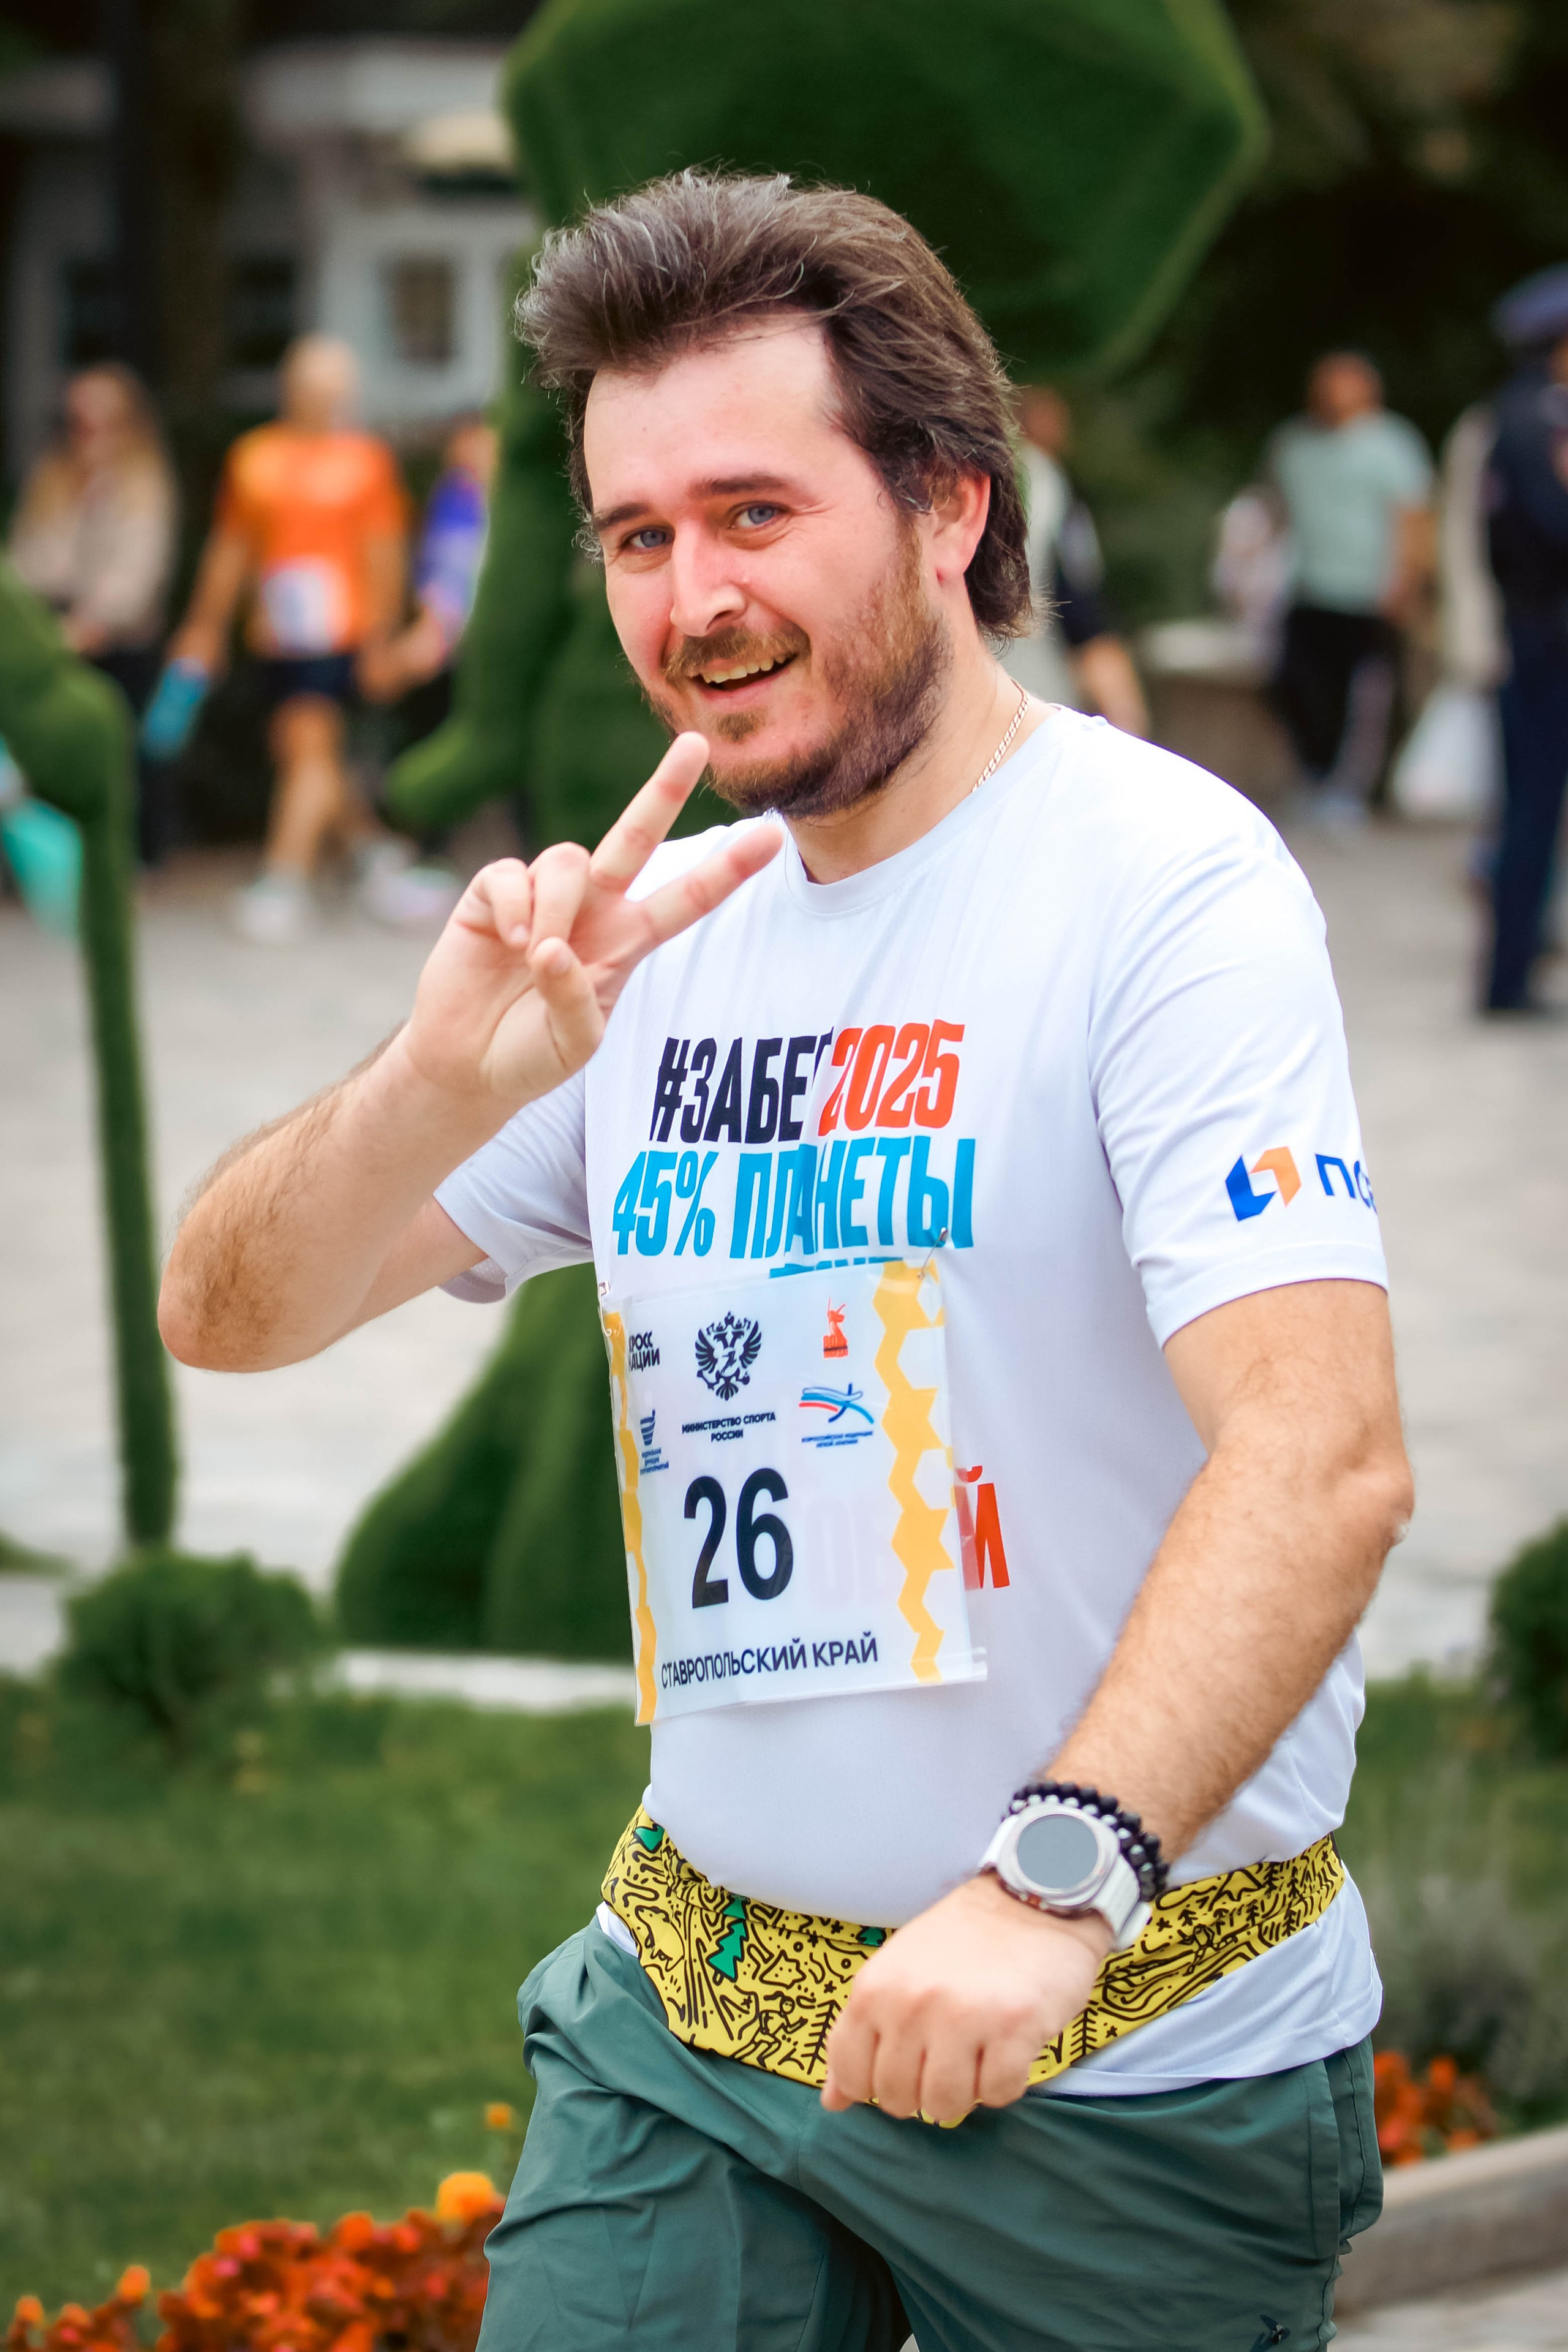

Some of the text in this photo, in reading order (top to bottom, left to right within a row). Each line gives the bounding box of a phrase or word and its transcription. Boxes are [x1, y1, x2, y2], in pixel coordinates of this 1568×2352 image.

[818, 1019, 965, 1138] 2025
[612, 1136, 976, 1260] 45% ПЛАНЕТЫ
[682, 1411, 777, 1435] МИНИСТЕРСТВО СПОРТА
[710, 1428, 744, 1443] РОССИИ
[682, 1467, 794, 1610] 26
[661, 1630, 878, 1690] СТАВРОПОЛЬСКИЙ КРАЙ
